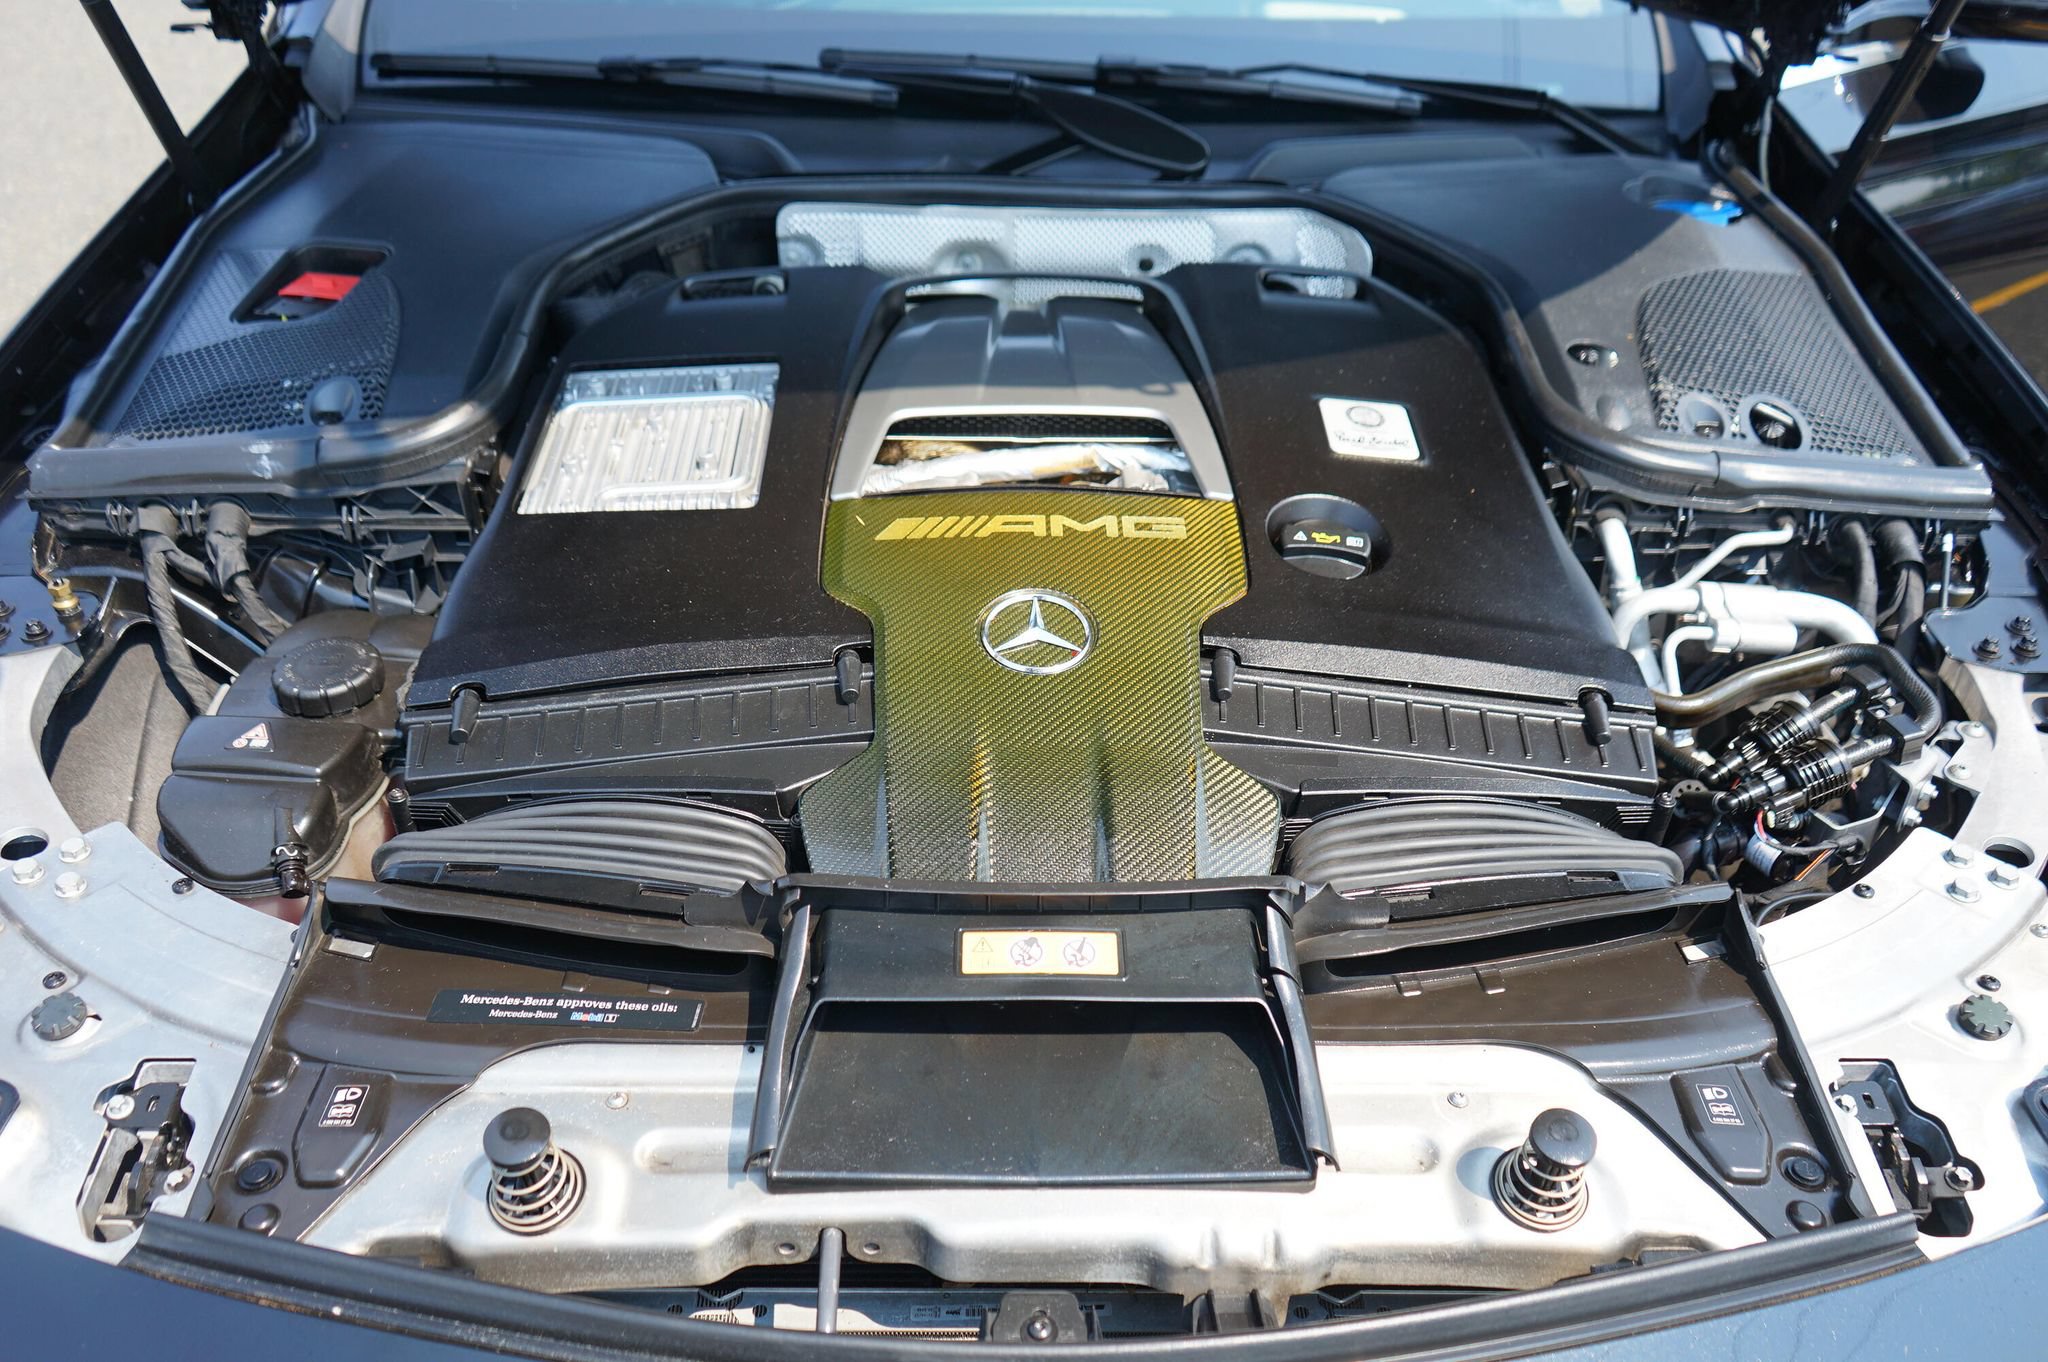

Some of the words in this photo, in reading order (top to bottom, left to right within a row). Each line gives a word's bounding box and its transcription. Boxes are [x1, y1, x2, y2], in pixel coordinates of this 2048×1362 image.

[974, 513, 1188, 538] AMG
[460, 994, 553, 1007] Mercedes-Benz
[556, 998, 613, 1009] approves
[615, 1000, 649, 1011] these
[651, 1002, 678, 1013] oils:
[488, 1009, 558, 1019] Mercedes-Benz
[570, 1011, 605, 1022] Mobil
